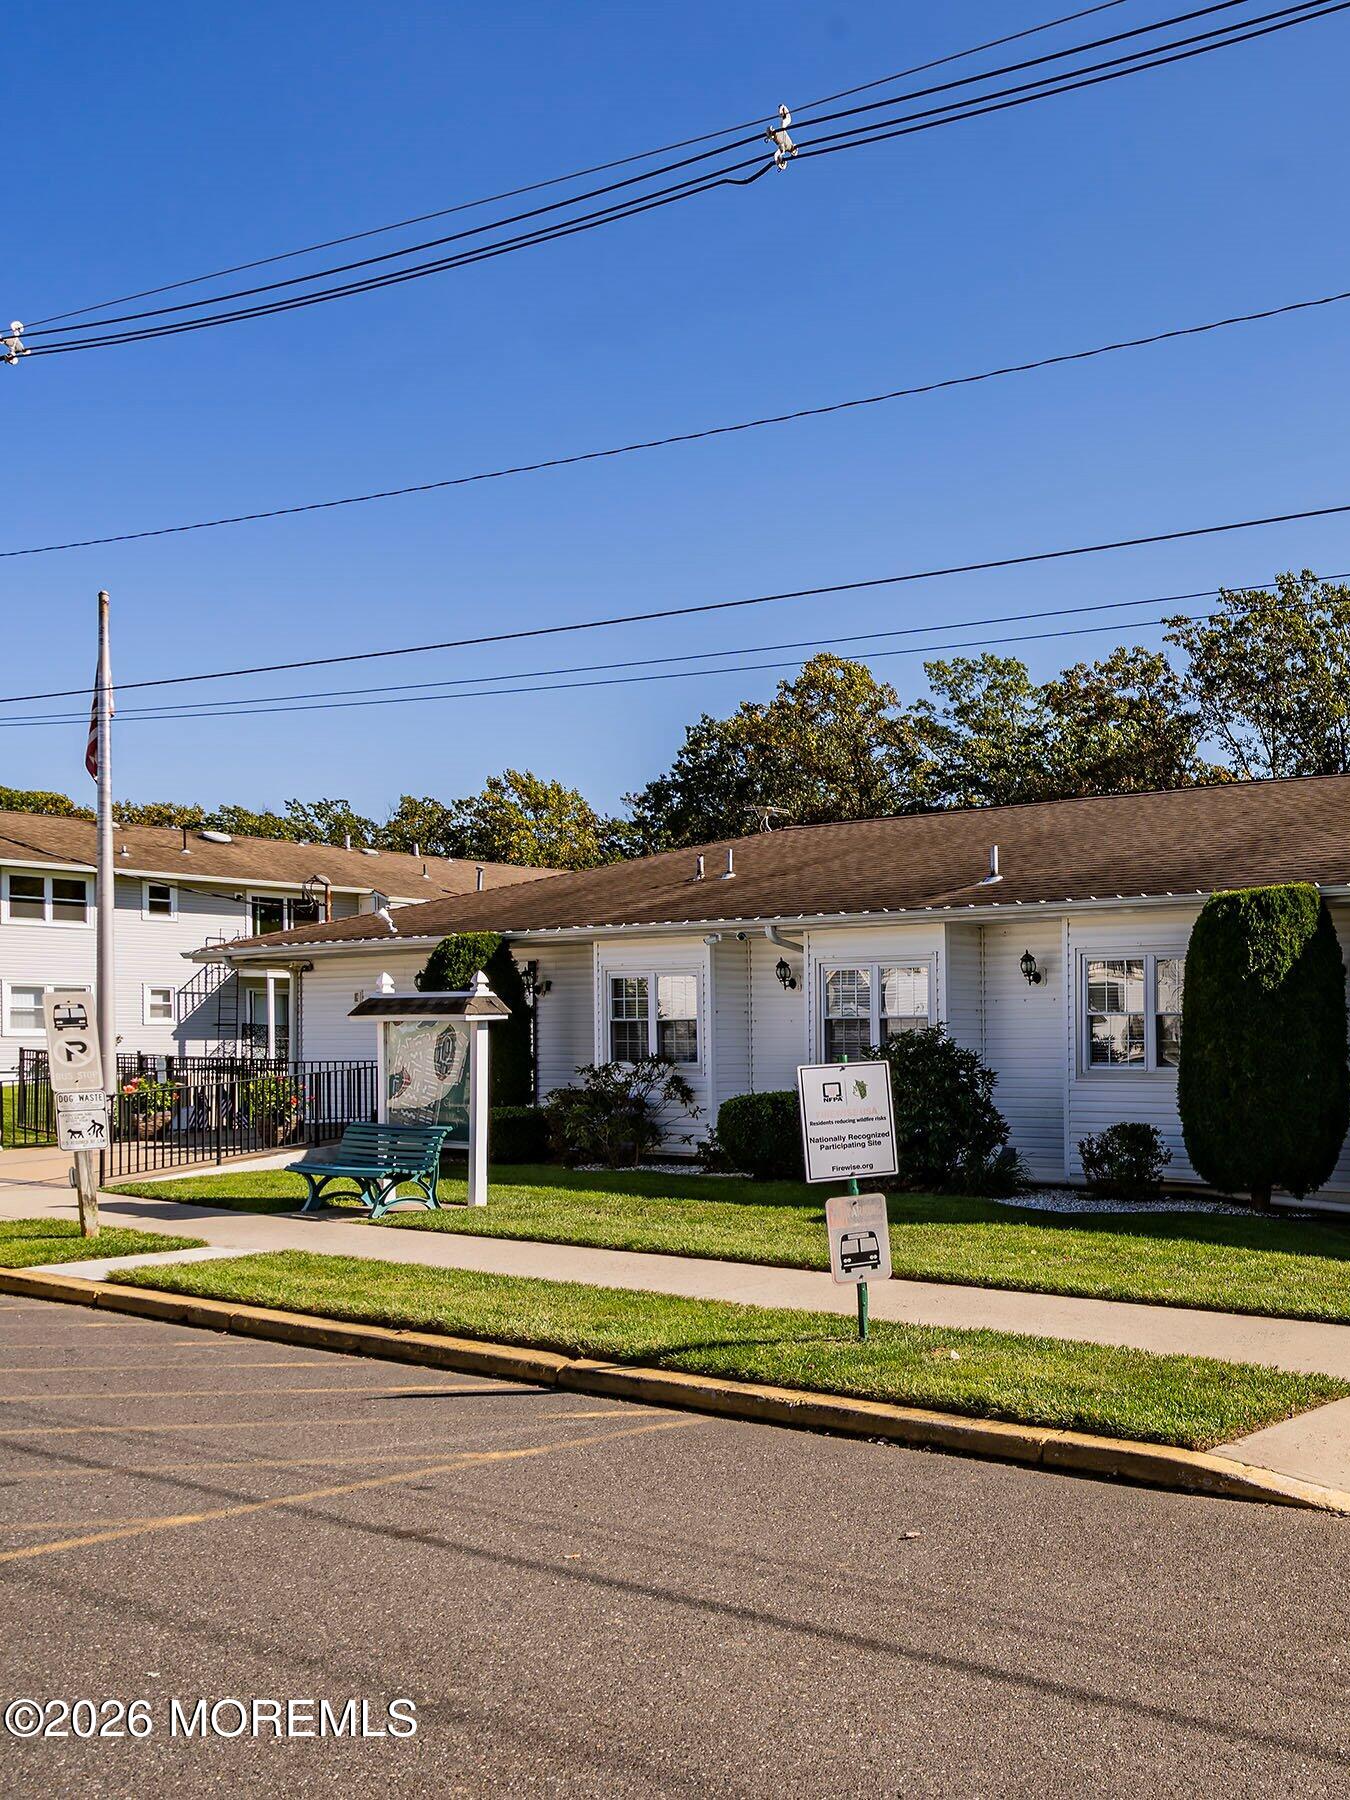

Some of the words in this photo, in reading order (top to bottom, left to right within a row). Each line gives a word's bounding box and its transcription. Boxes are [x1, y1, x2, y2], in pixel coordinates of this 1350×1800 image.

[58, 1095, 74, 1103] DOG
[78, 1093, 103, 1102] WASTE
[809, 1134, 846, 1144] Nationally
[848, 1131, 890, 1141] Recognized
[819, 1141, 866, 1151] Participating
[867, 1139, 882, 1147] Site
[832, 1163, 874, 1172] Firewise.org
